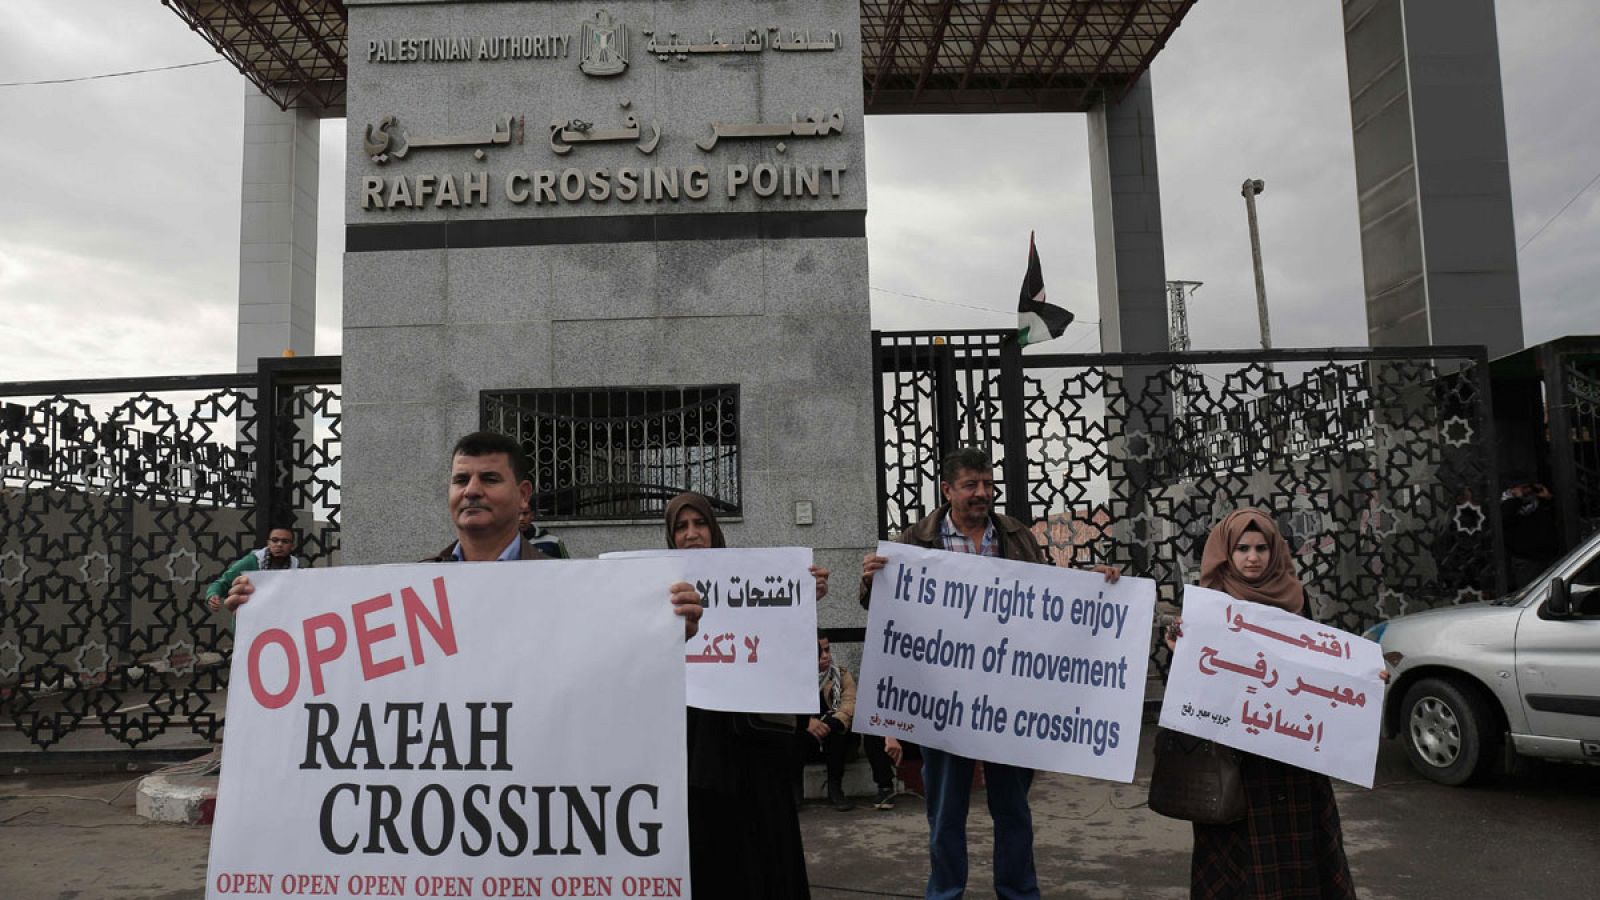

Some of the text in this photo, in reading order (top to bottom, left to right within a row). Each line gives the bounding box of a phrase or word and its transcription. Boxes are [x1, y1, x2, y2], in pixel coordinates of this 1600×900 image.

[367, 34, 571, 62] PALESTINIAN AUTHORITY
[643, 26, 842, 62] السلطة الفلسطينية
[362, 96, 845, 163] معبر رفح البري
[361, 161, 847, 210] RAFAH CROSSING POINT
[696, 575, 801, 608] الفتحات الا
[895, 563, 1128, 638] It is my right to enjoy
[247, 576, 459, 710] OPEN
[685, 632, 760, 663] لا تكف
[883, 620, 1127, 689] freedom of movement
[1226, 604, 1351, 659] افتحوا
[1199, 646, 1366, 708] معبر رفح
[299, 701, 514, 771] RAFAH
[877, 676, 1120, 756] through the crossings
[319, 783, 663, 857] CROSSING
[216, 873, 682, 897] OPEN OPEN OPEN OPEN OPEN OPEN OPEN
